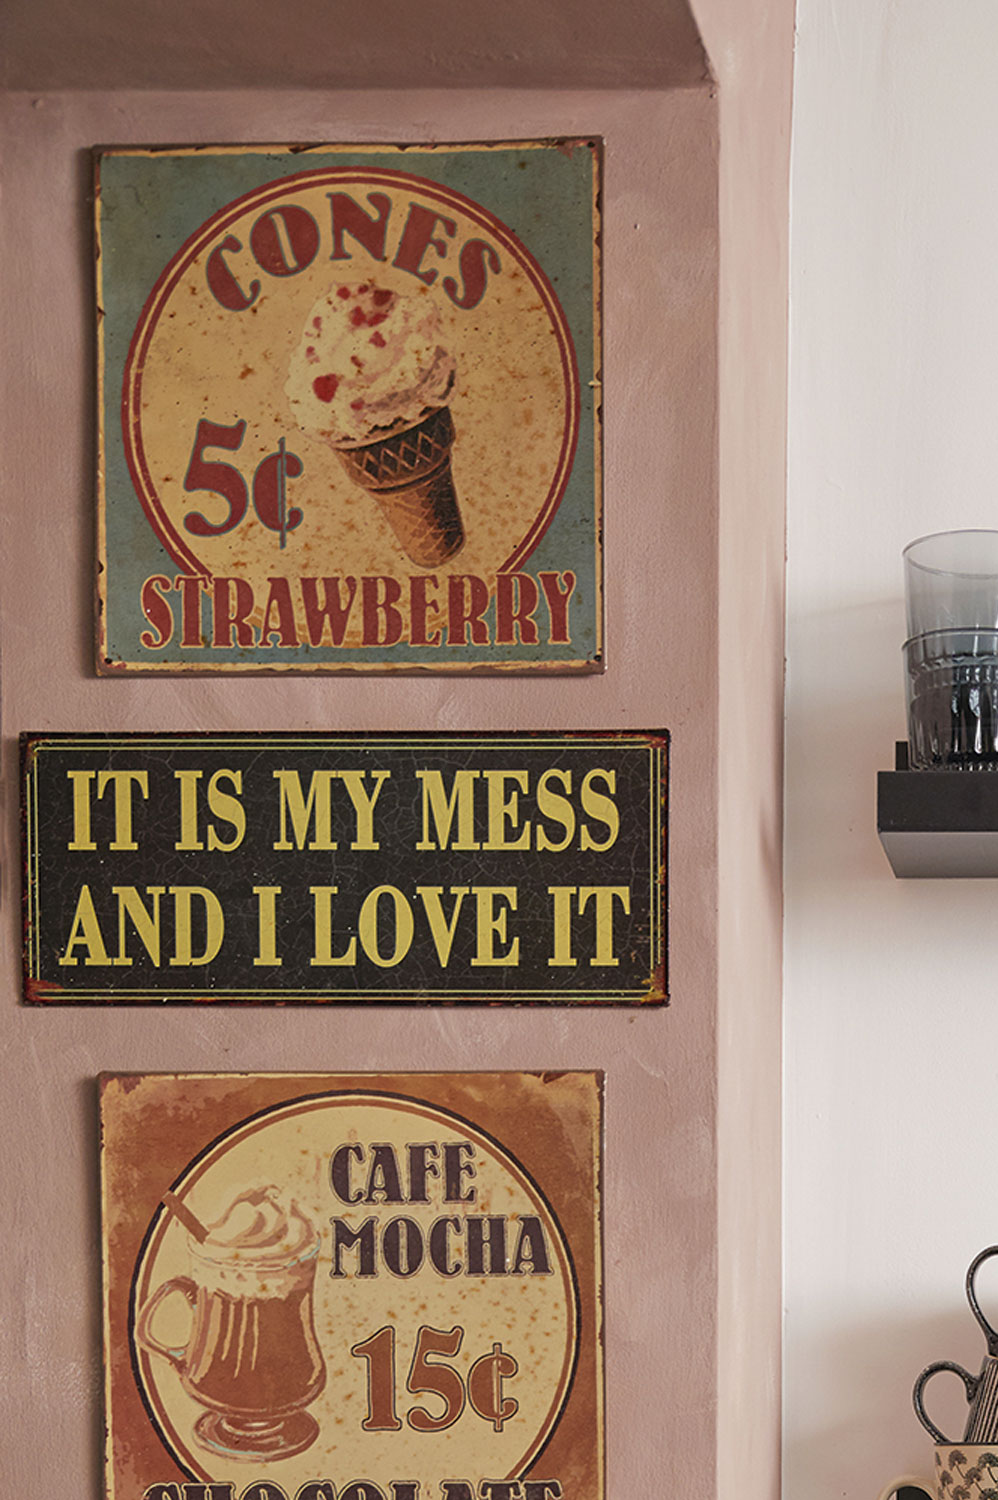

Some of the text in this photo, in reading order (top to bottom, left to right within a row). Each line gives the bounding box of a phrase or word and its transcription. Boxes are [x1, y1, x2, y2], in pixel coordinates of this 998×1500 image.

[206, 191, 501, 311] CONES
[182, 418, 304, 549] 5¢
[140, 571, 577, 649] STRAWBERRY
[67, 768, 620, 852] IT IS MY MESS
[58, 884, 630, 968] AND I LOVE IT
[330, 1141, 477, 1205] CAFE
[330, 1215, 554, 1278] MOCHA
[351, 1325, 519, 1433] 15¢
